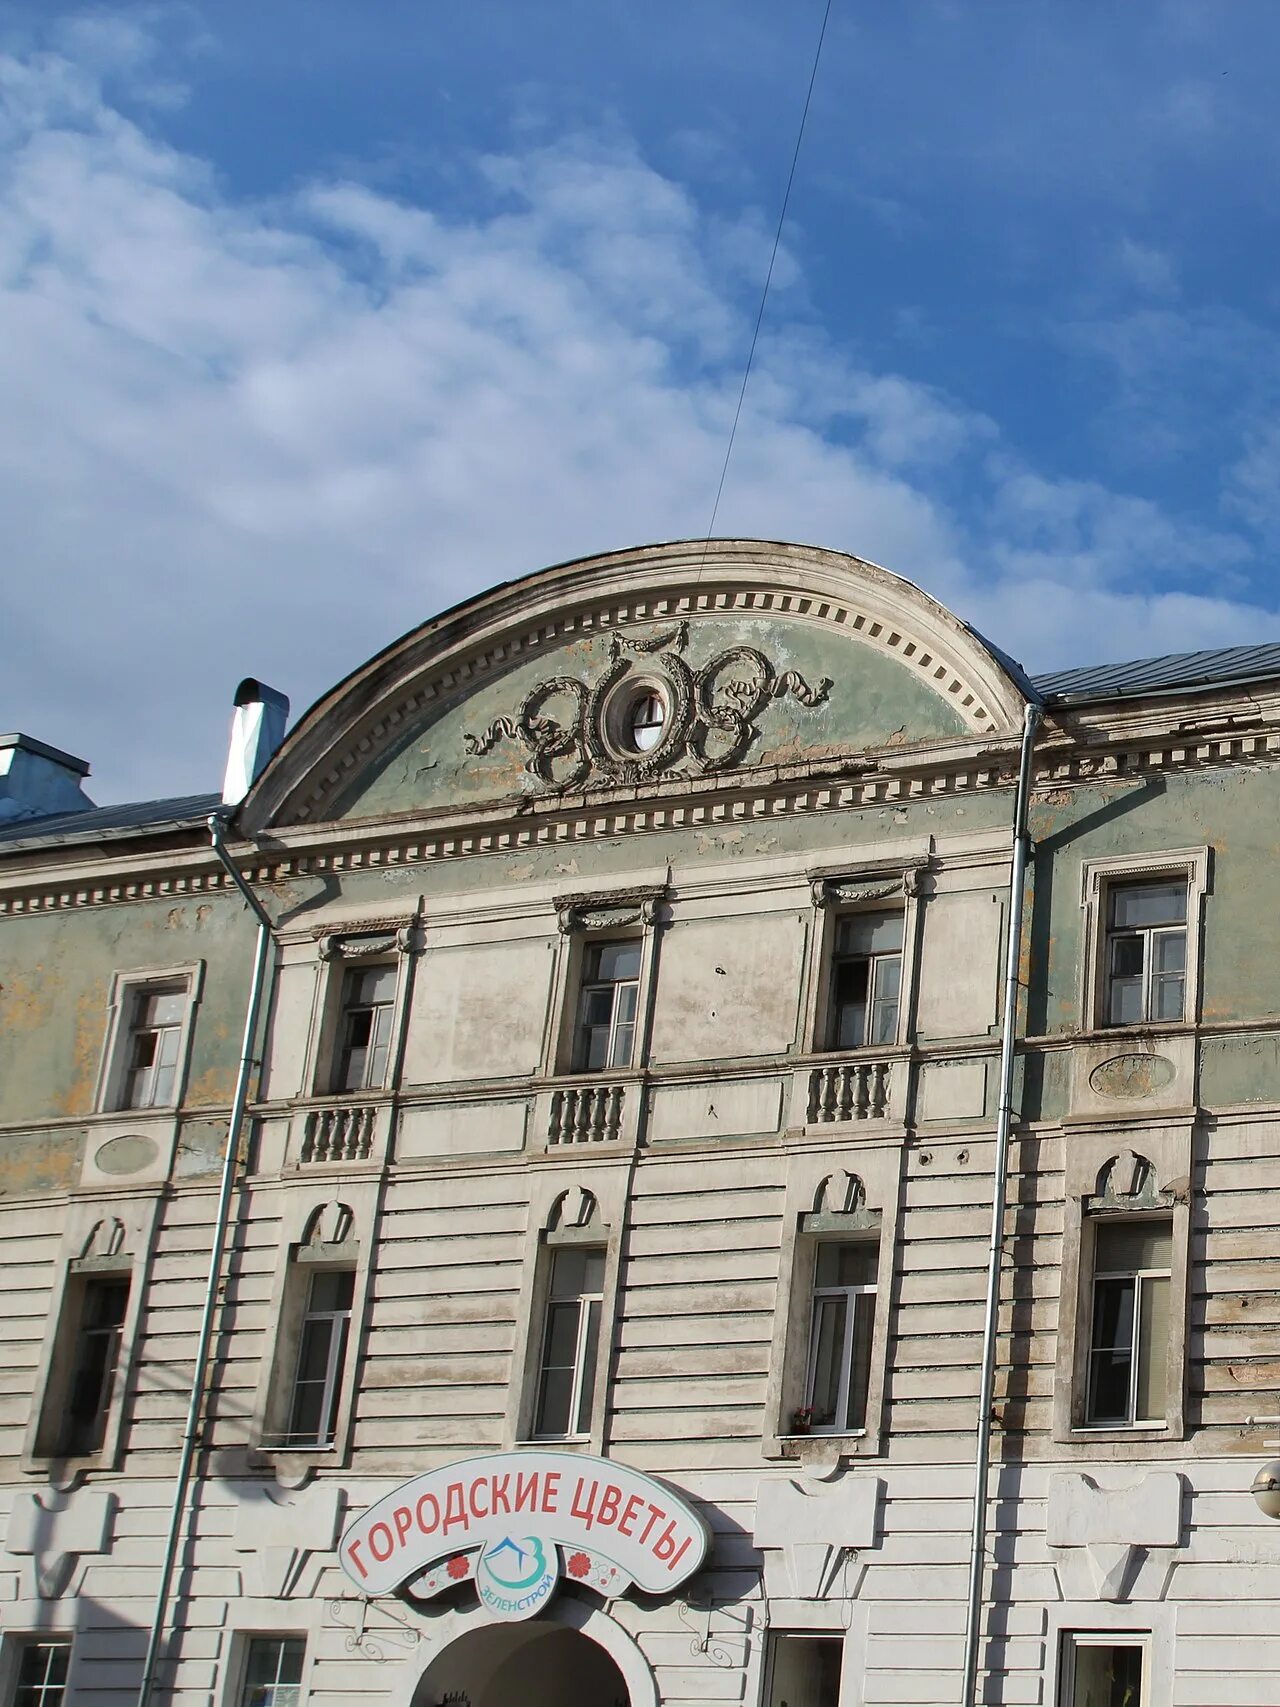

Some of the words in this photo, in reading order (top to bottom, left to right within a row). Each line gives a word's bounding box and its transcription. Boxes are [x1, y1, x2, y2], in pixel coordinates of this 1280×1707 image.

[347, 1472, 562, 1579] ГОРОДСКИЕ
[570, 1476, 693, 1572] ЦВЕТЫ
[480, 1573, 555, 1612] ЗЕЛЕНСТРОЙ
